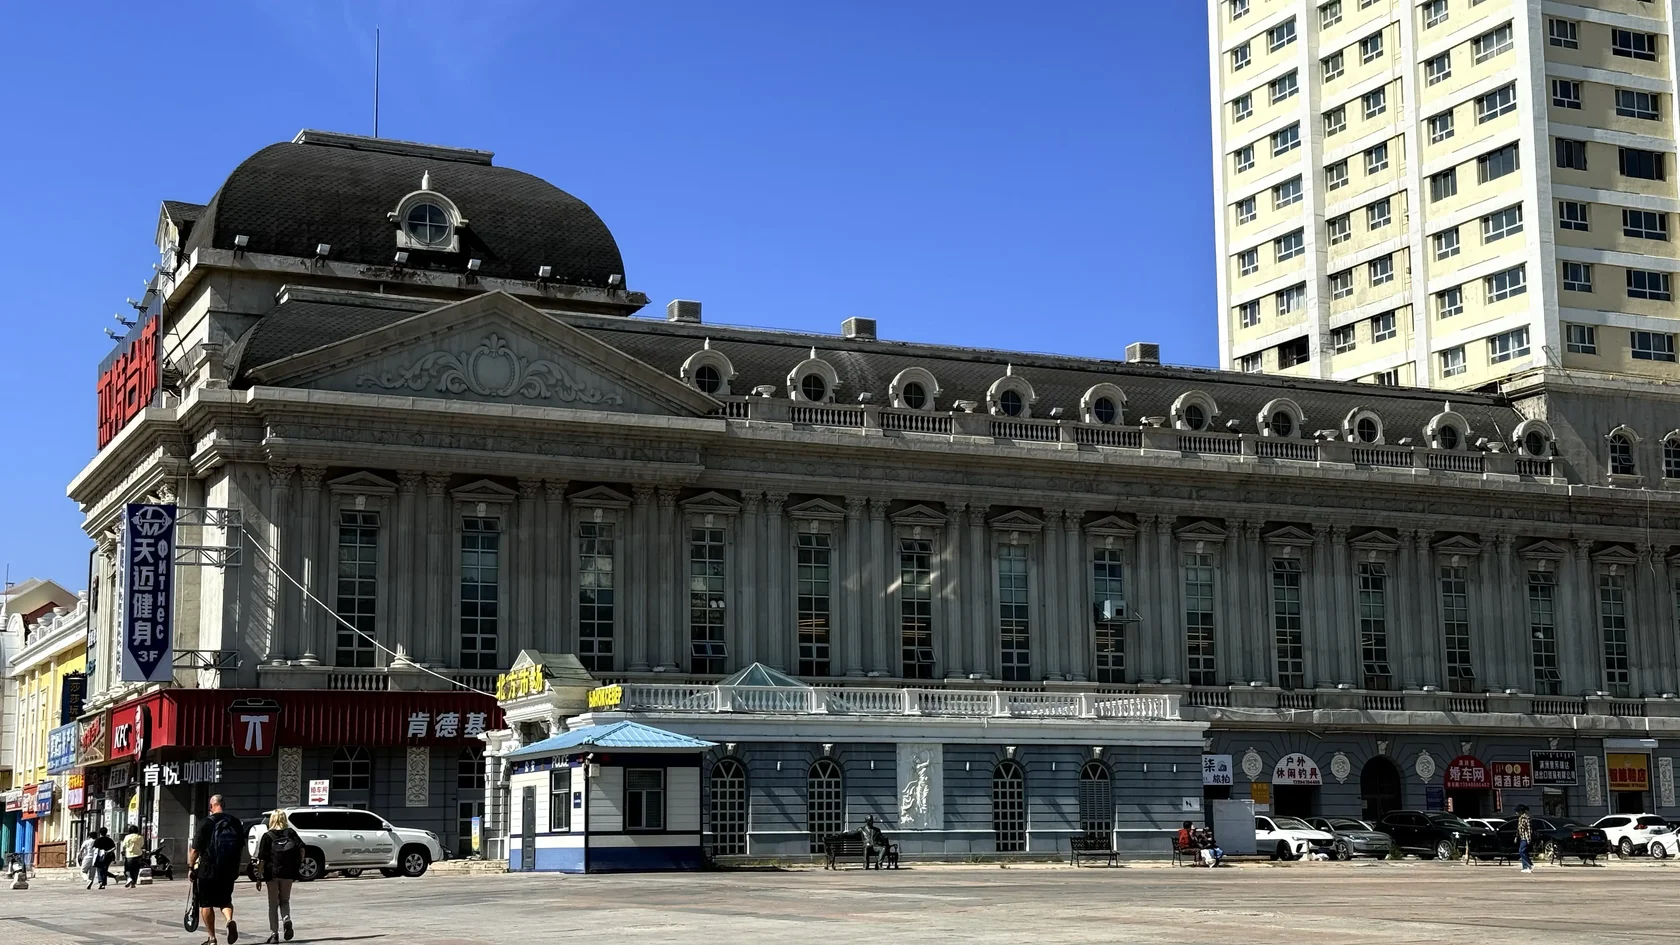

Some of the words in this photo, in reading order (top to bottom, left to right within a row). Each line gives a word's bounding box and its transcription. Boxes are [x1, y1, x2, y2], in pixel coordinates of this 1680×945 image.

[132, 538, 155, 646] 天迈健身
[138, 650, 159, 662] 3F
[495, 664, 544, 700] 北方市场
[407, 712, 487, 738] 肯德基
[114, 723, 130, 750] KFC
[551, 754, 570, 768] POLICE
[1286, 756, 1306, 767] 户外
[143, 759, 223, 787] 肯悦咖啡
[1212, 774, 1231, 784] 旅拍
[1276, 768, 1319, 779] 休闲钓具
[1449, 766, 1485, 782] 婚车网
[1494, 775, 1530, 787] 烟酒超市
[341, 847, 394, 855] PRADO
